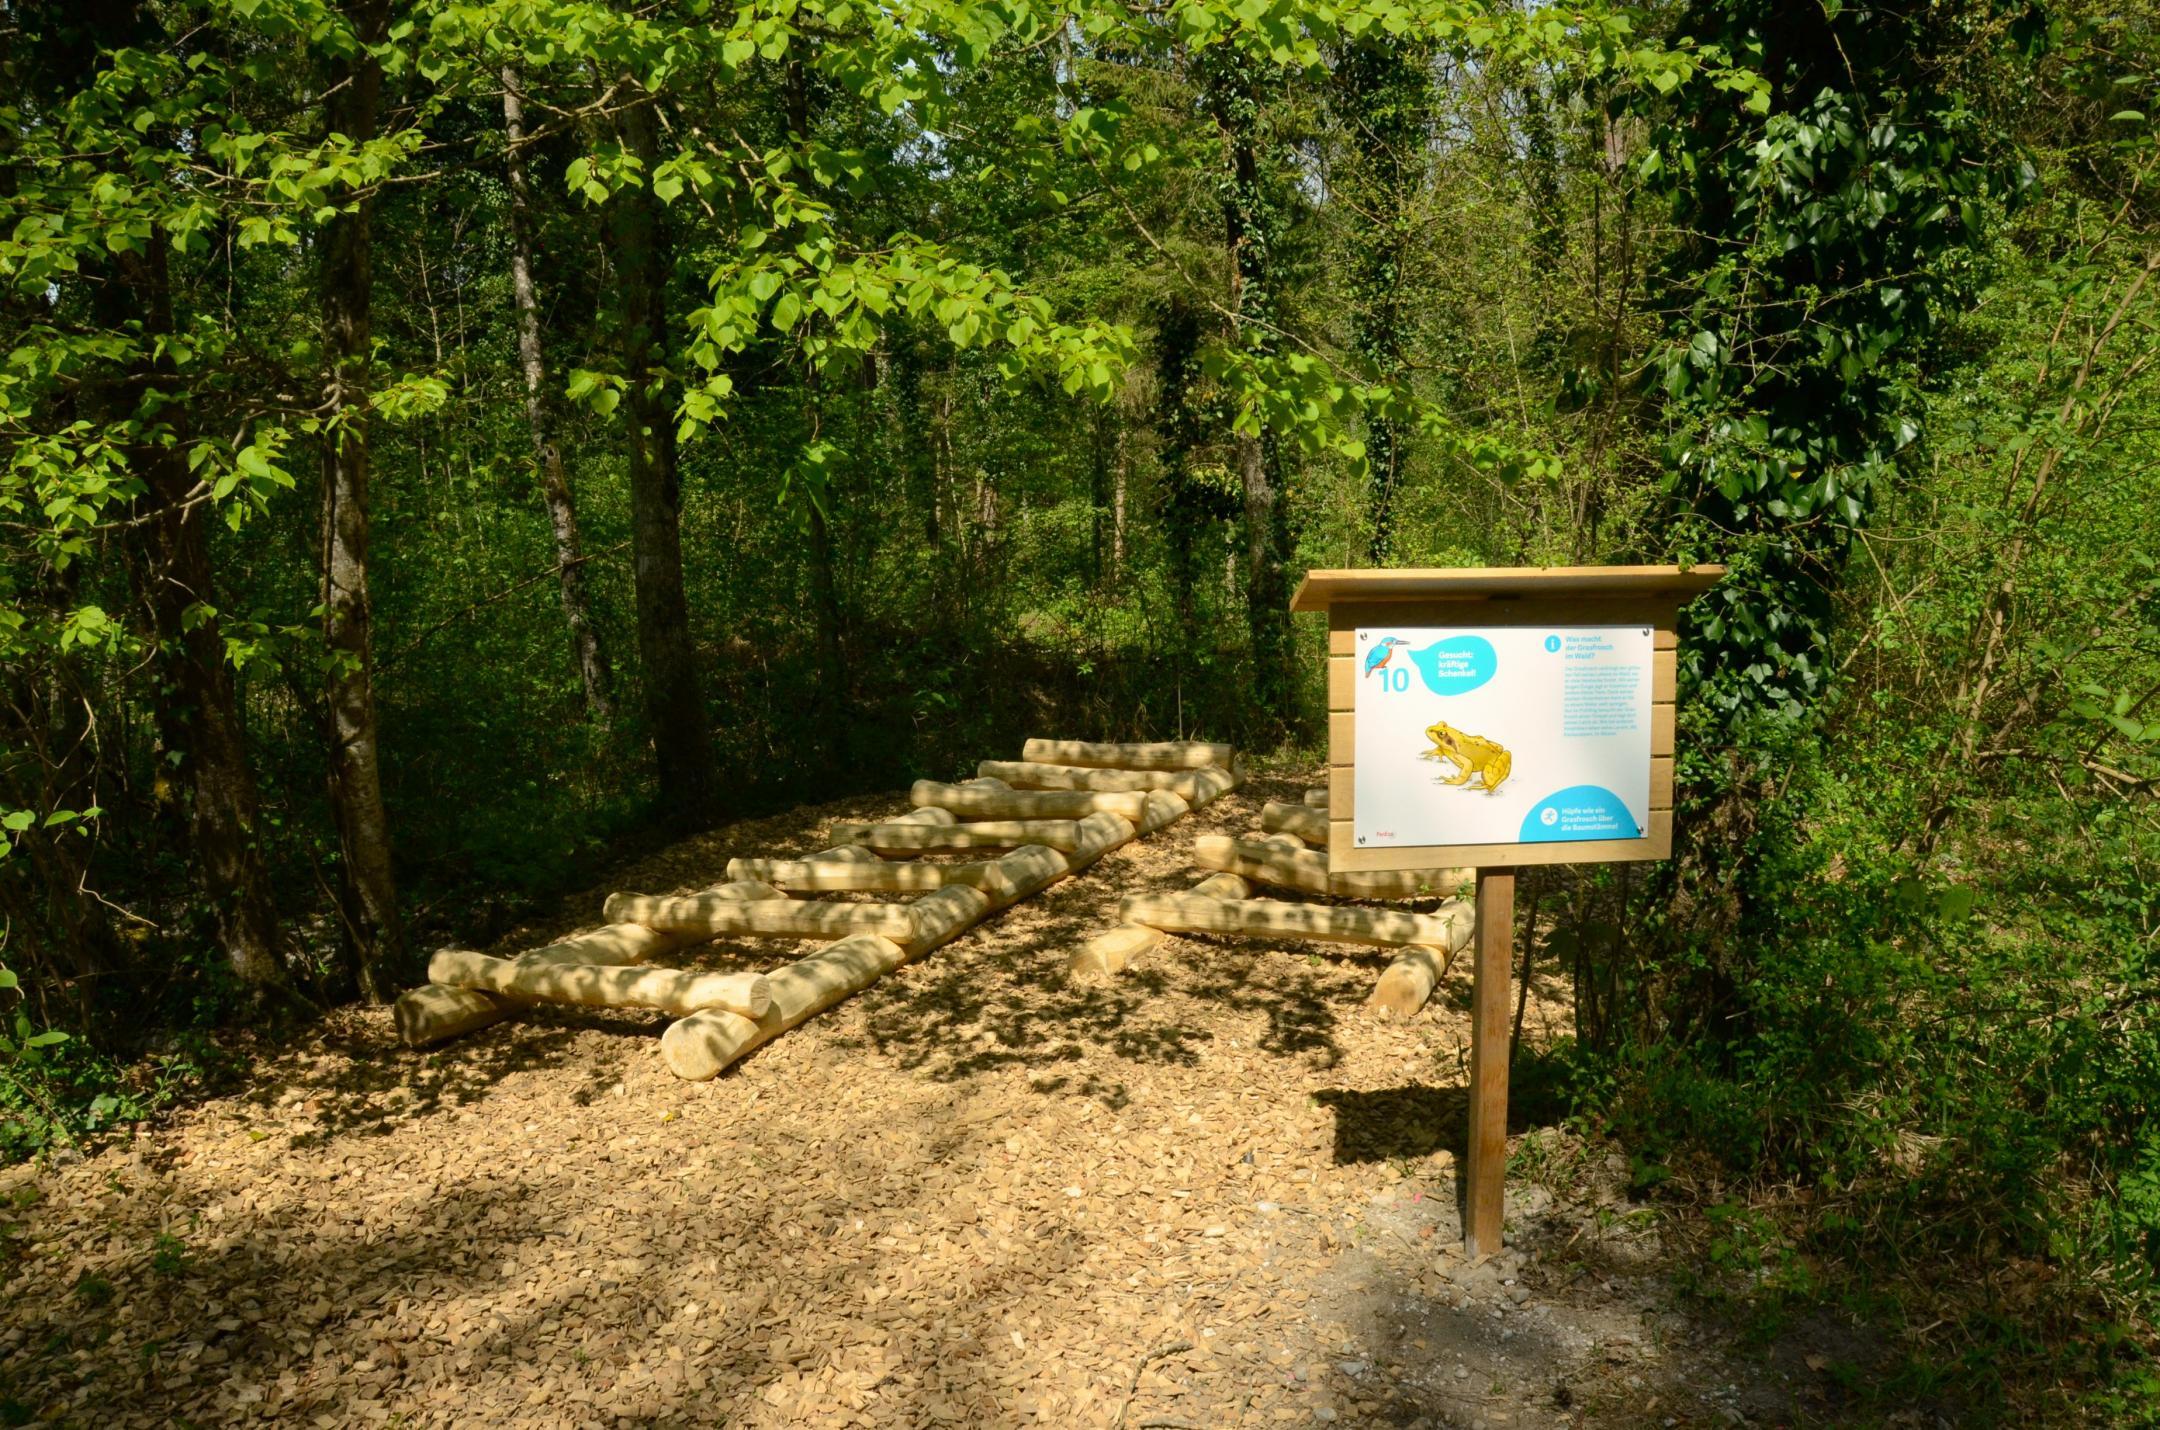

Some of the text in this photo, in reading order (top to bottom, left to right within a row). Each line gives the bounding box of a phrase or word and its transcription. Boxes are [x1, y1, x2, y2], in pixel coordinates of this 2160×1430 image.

[1438, 651, 1473, 659] Gesucht:
[1438, 660, 1468, 669] kräftige
[1379, 668, 1410, 693] 10
